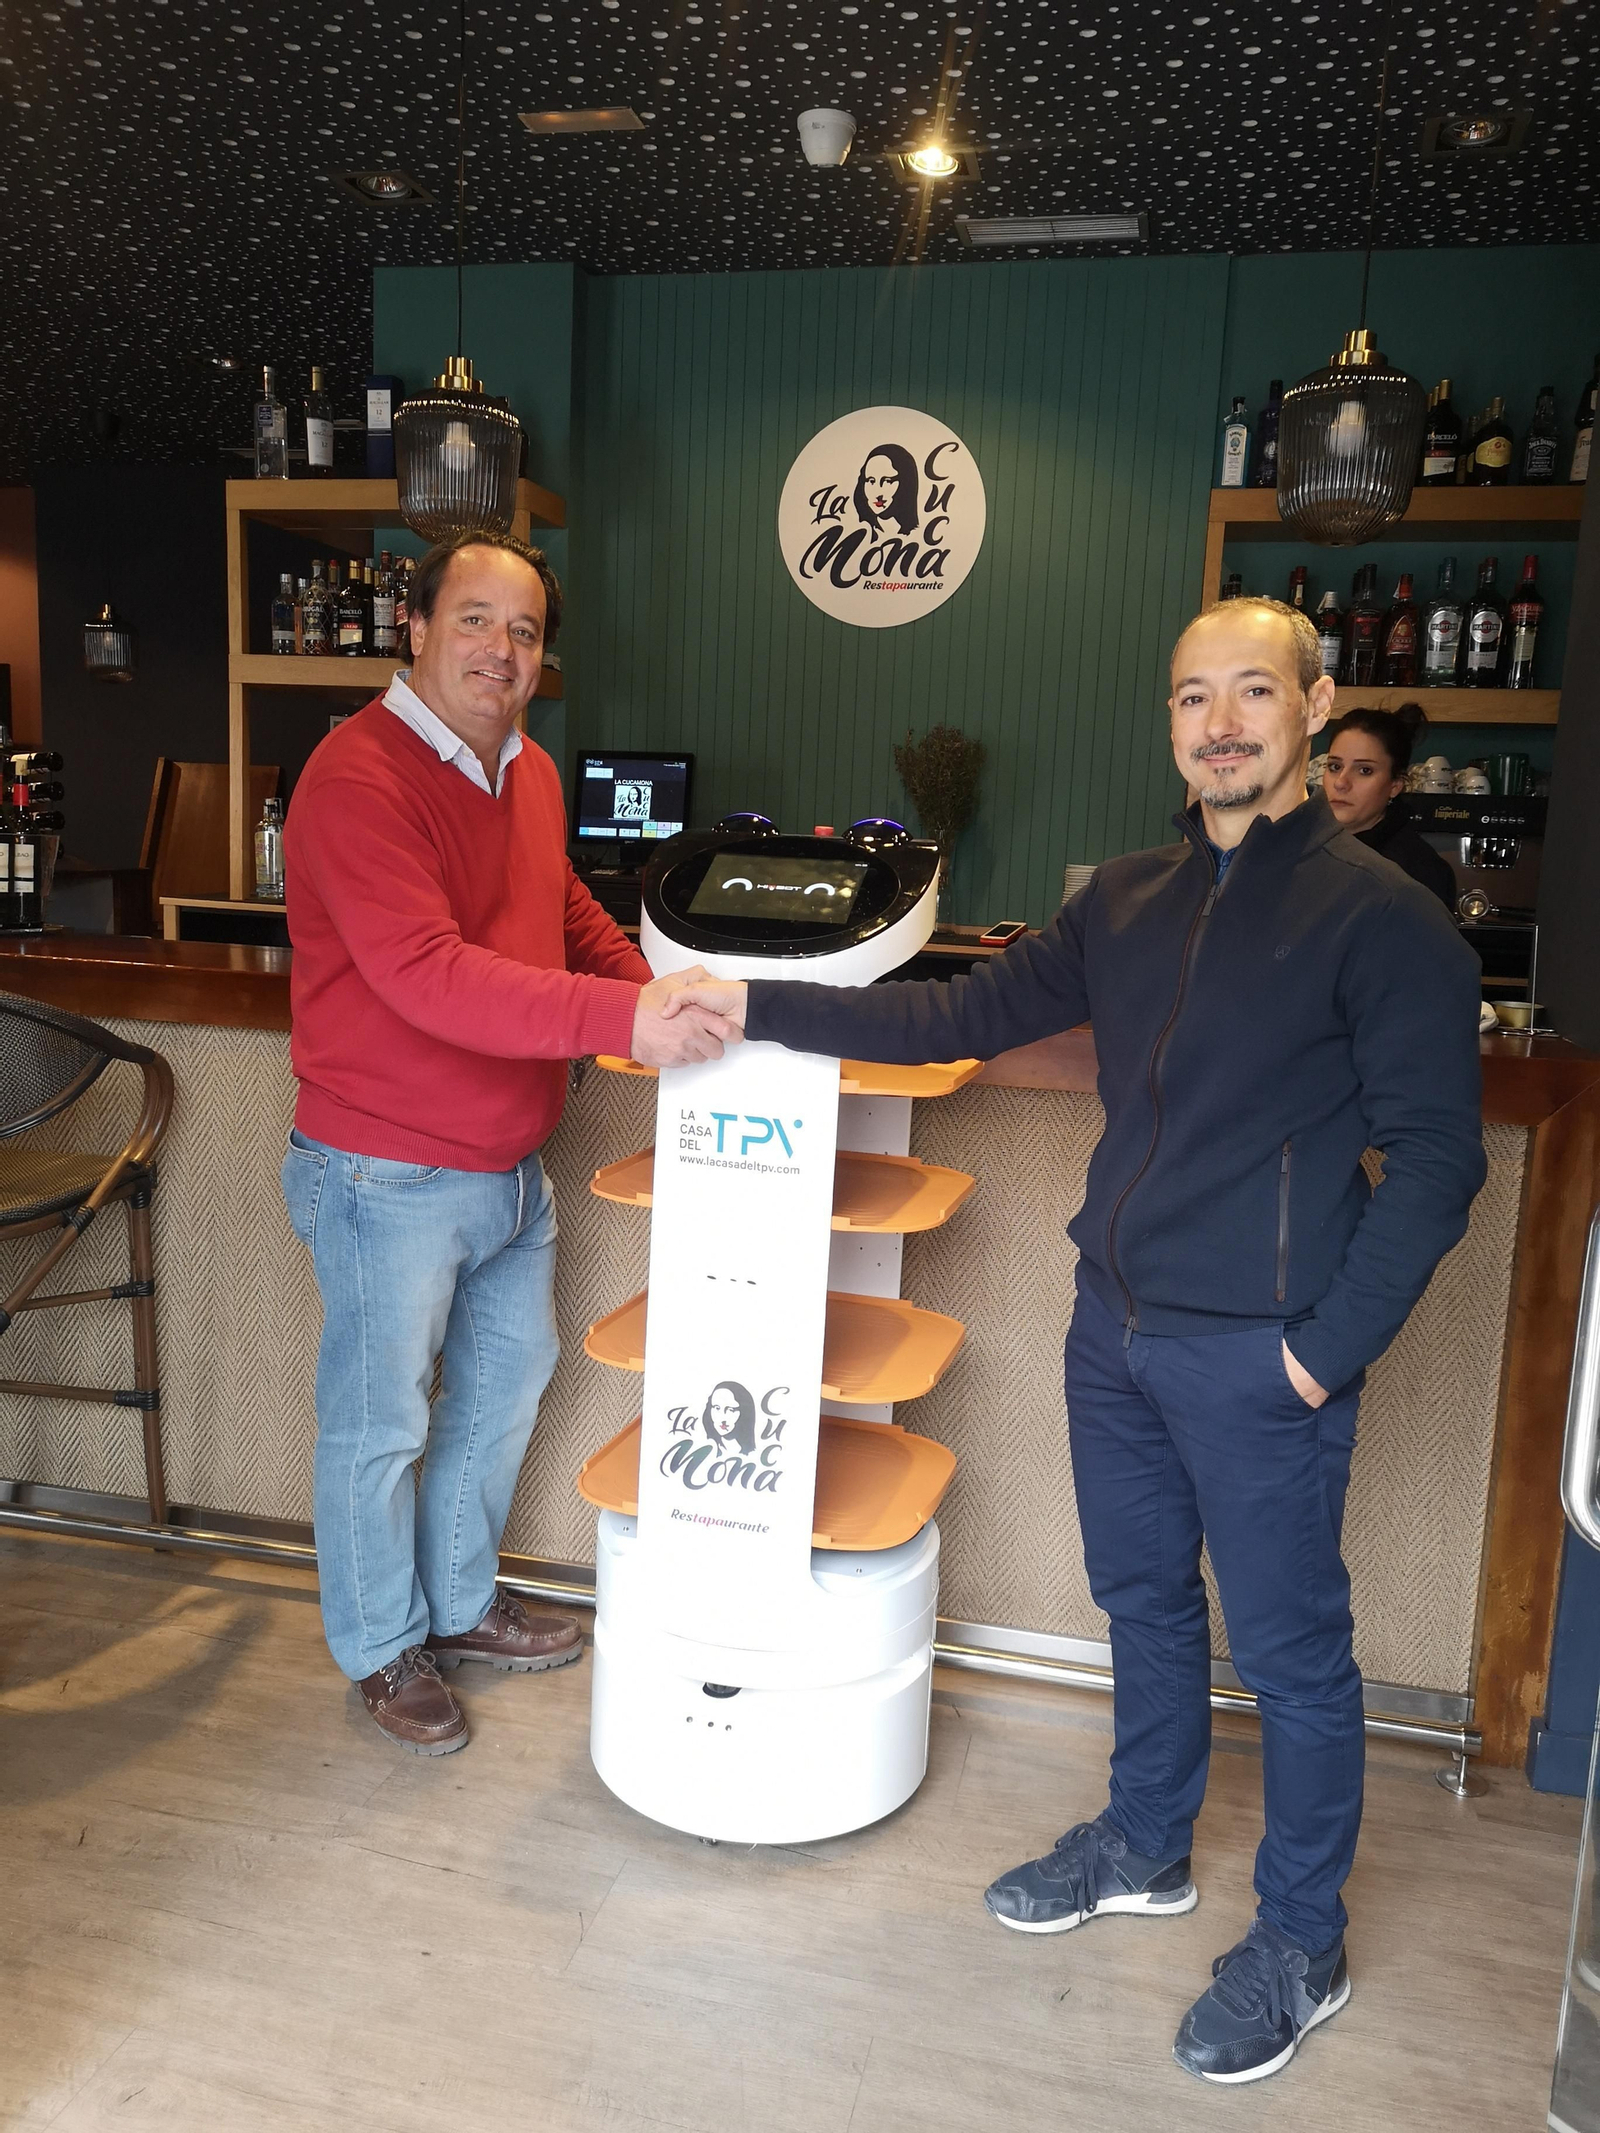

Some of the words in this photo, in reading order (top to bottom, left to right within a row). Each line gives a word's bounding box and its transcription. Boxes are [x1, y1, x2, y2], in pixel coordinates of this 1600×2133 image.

[809, 484, 850, 525] La
[799, 525, 952, 589] Mona
[862, 580, 944, 592] Restapaurante
[339, 607, 363, 616] BARCELÓ
[1434, 809, 1470, 819] Imperiale
[681, 1109, 696, 1122] LA
[680, 1124, 713, 1138] CASA
[679, 1138, 702, 1151] DEL
[679, 1154, 801, 1175] www.lacasadeltpv.com
[667, 1406, 699, 1436] La
[660, 1439, 784, 1492] Mona
[671, 1508, 770, 1534] Restapaurante
